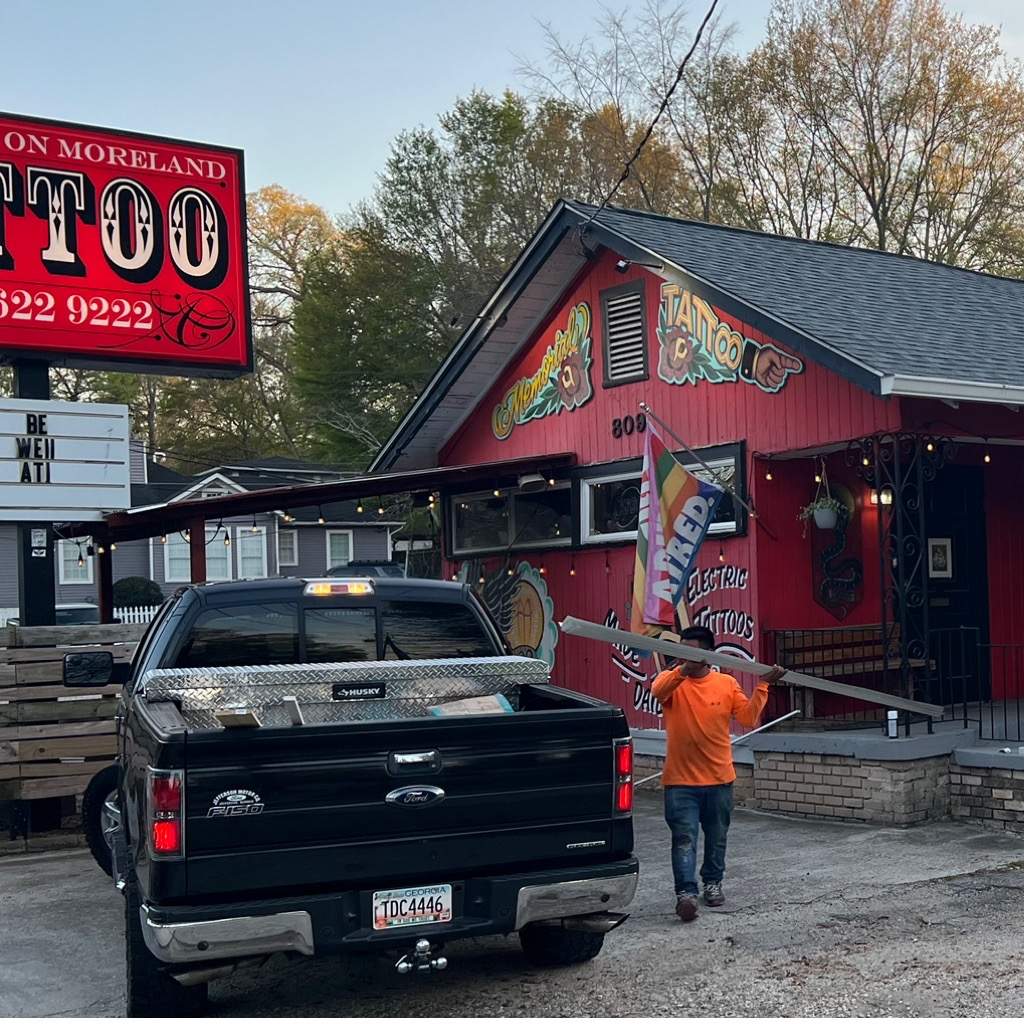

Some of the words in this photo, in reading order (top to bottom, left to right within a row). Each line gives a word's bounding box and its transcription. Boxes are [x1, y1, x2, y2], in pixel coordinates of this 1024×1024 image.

[4, 131, 50, 155] ON
[57, 138, 226, 180] MORELAND
[66, 294, 154, 330] 9222
[661, 282, 744, 371] TATTOO
[26, 413, 48, 435] BE
[687, 564, 749, 607] ELECTRIC
[349, 687, 381, 696] HUSKY
[403, 791, 429, 803] Ford
[404, 886, 447, 898] GEORGIA
[381, 895, 443, 919] TDC4446
